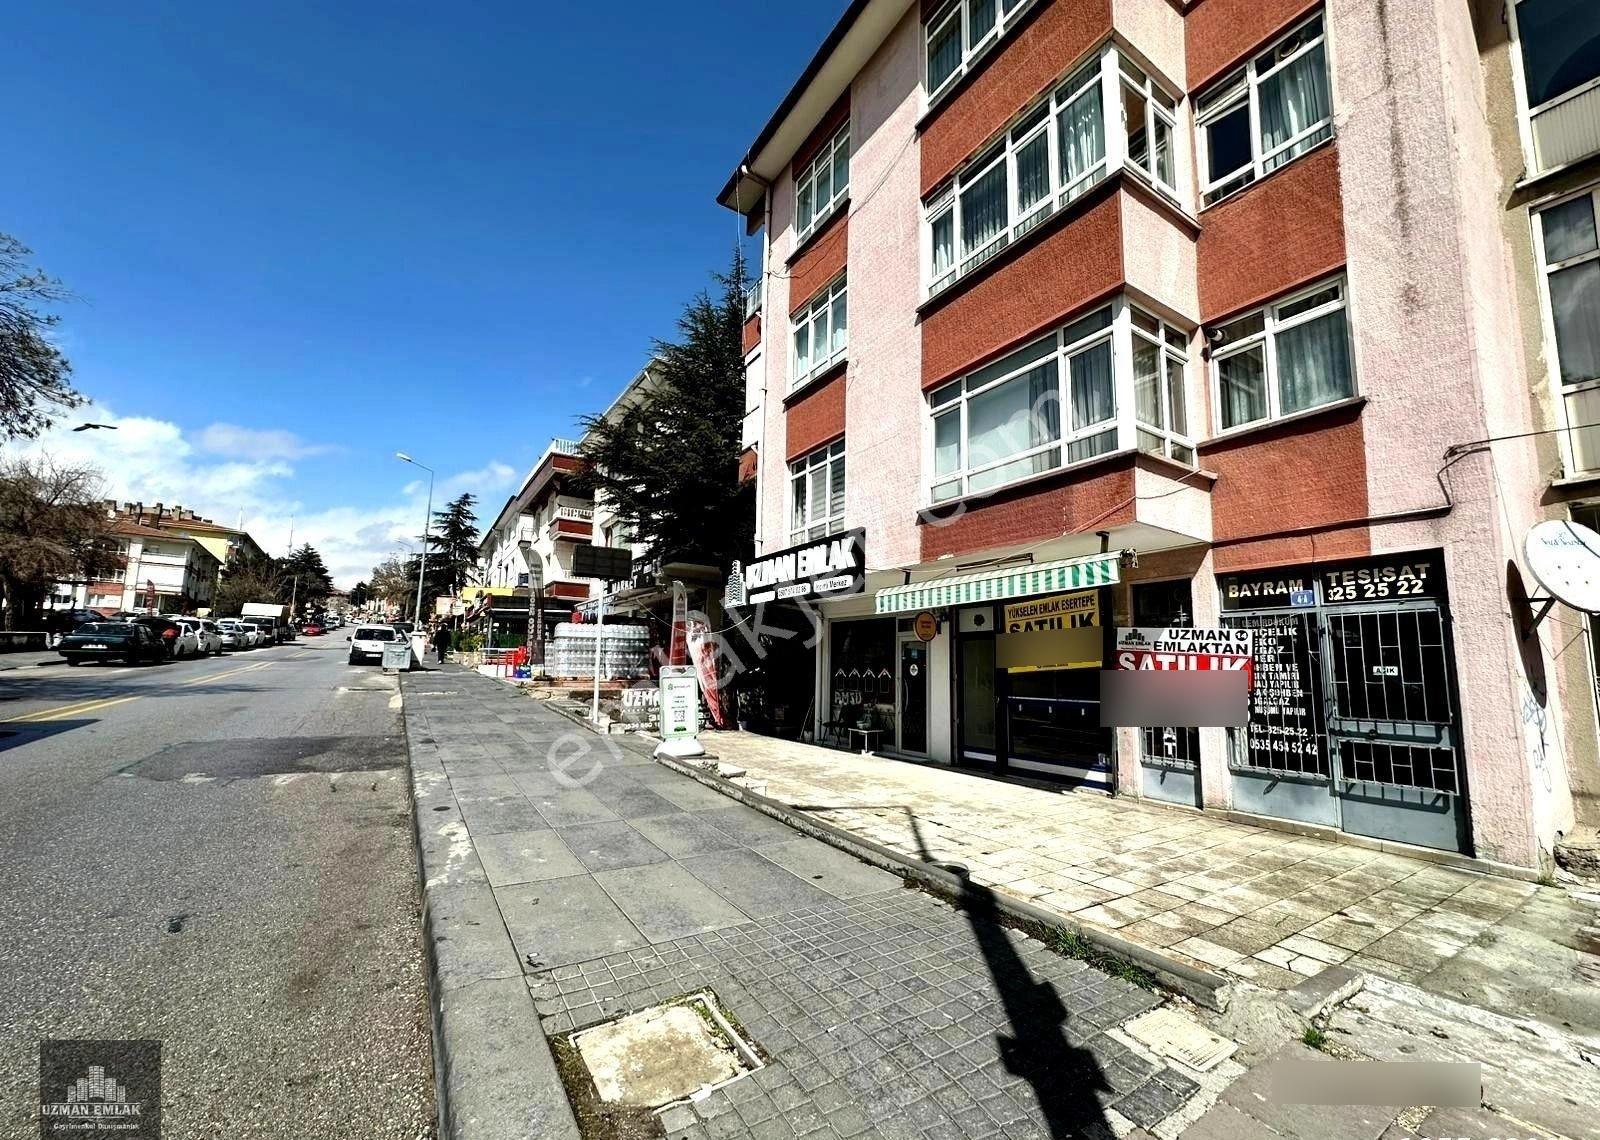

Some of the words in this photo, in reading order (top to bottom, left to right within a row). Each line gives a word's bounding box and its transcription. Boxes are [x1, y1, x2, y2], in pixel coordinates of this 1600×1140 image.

[1228, 579, 1304, 598] BAYRAM
[1328, 585, 1357, 601] 325
[1363, 582, 1390, 598] 25
[1397, 579, 1425, 595] 22
[1007, 605, 1039, 619] YÜKSELEN
[1039, 601, 1060, 613] EMLAK
[1061, 594, 1096, 611] ESERTEPE
[1169, 629, 1231, 642] UZMAN
[1153, 641, 1248, 655] EMLAKTAN
